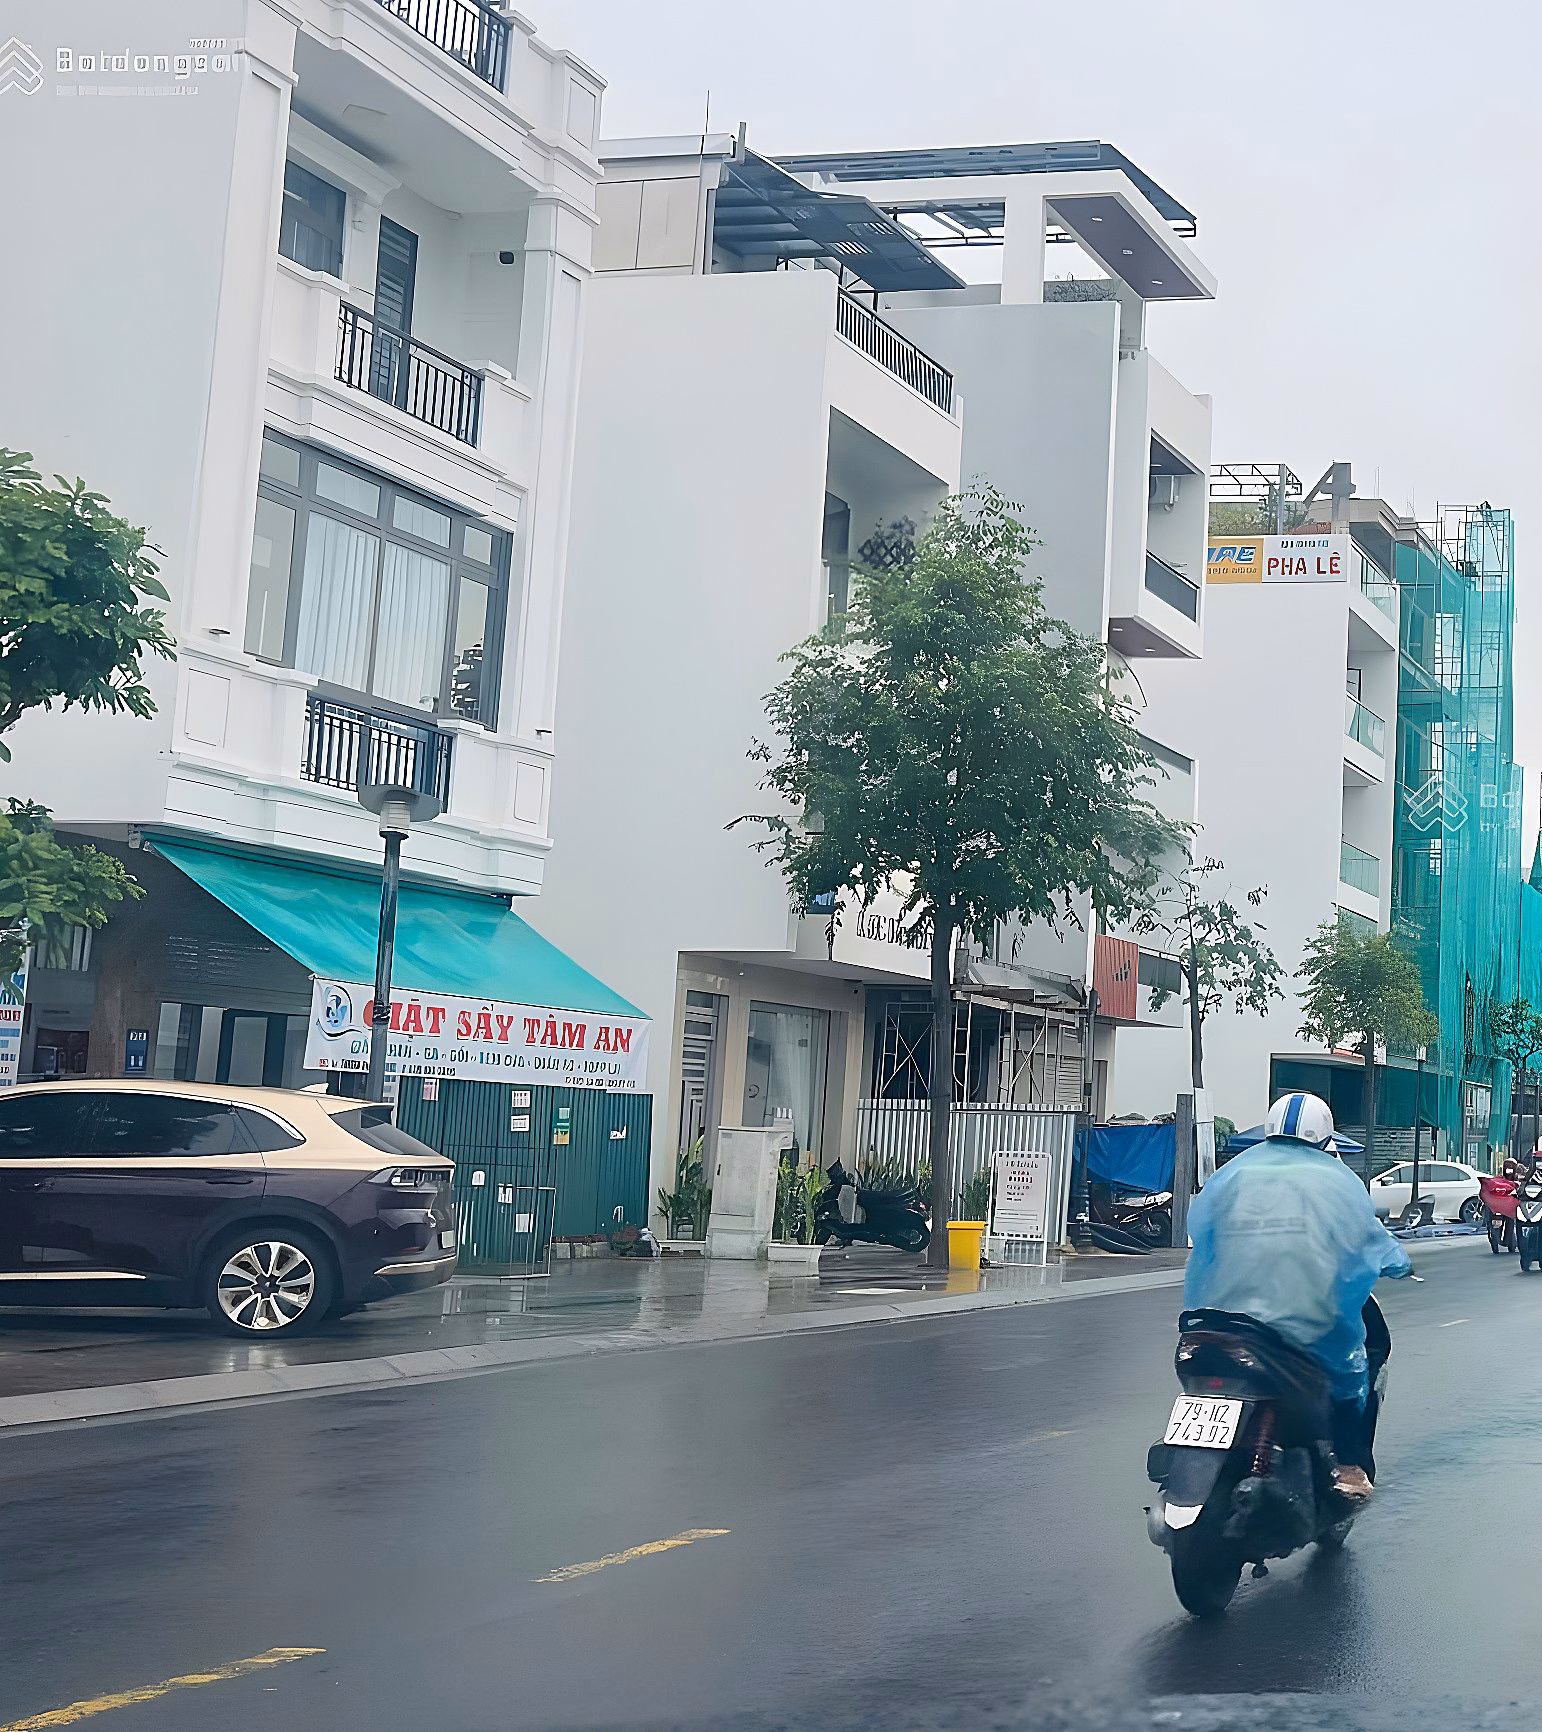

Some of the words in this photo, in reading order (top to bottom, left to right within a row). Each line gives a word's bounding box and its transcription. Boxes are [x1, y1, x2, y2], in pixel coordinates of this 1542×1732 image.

[1266, 556, 1307, 576] PHA
[1316, 551, 1341, 575] LÊ
[593, 1026, 633, 1053] AN
